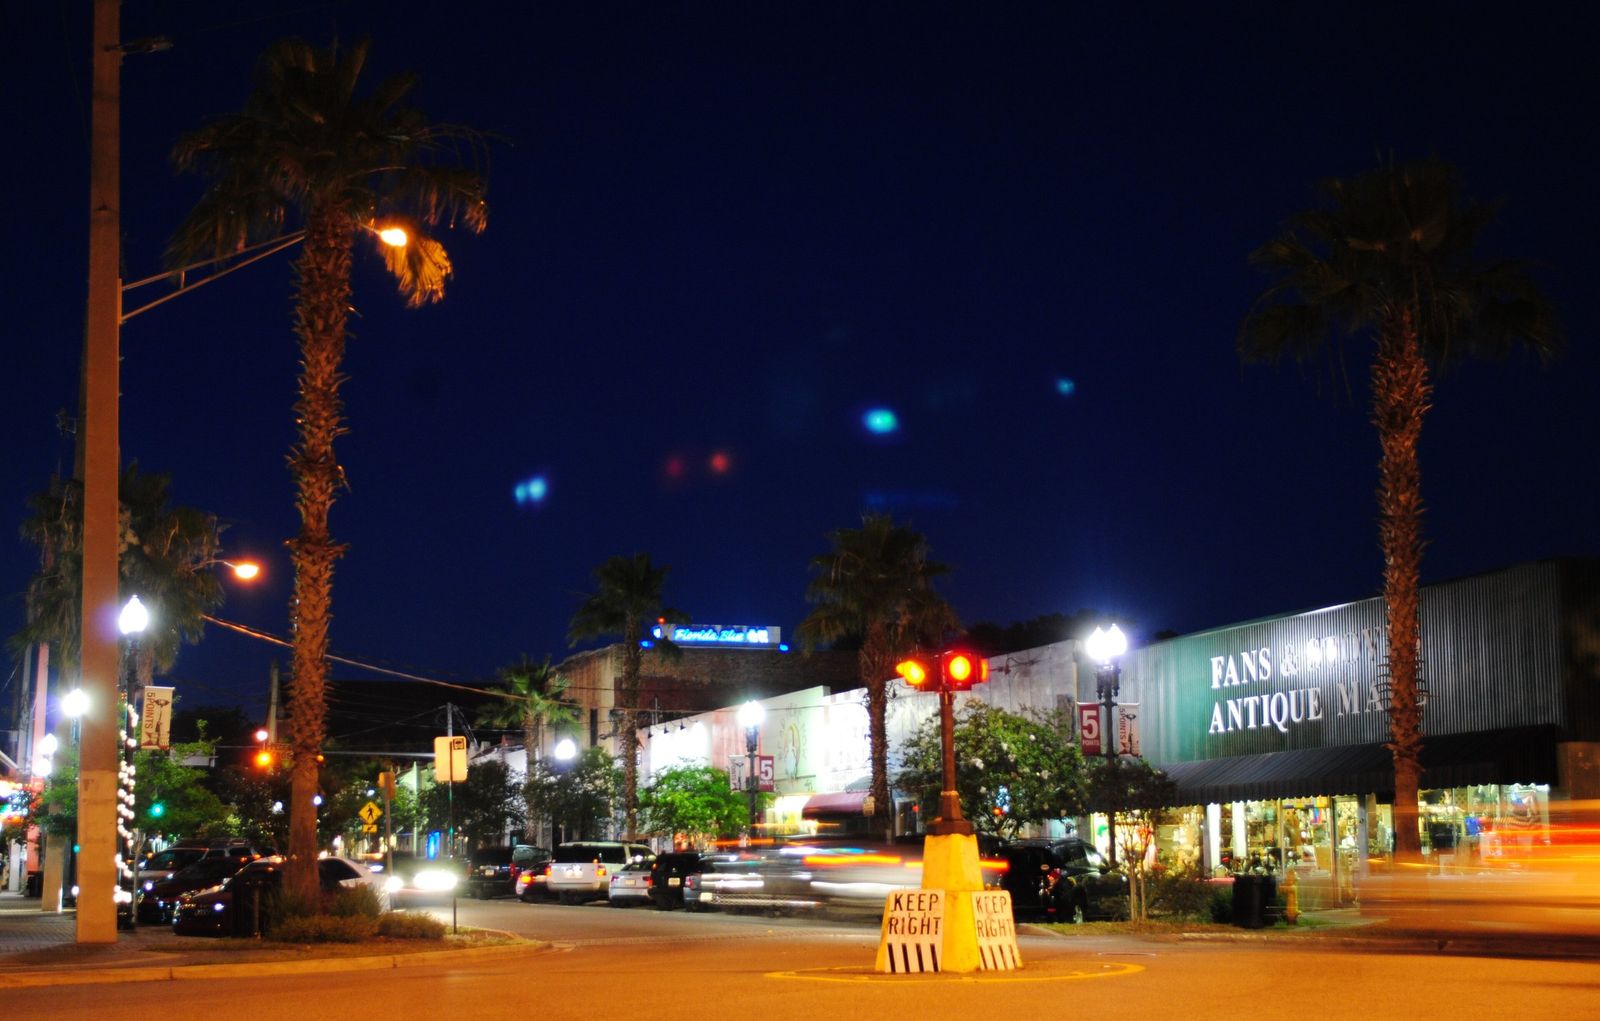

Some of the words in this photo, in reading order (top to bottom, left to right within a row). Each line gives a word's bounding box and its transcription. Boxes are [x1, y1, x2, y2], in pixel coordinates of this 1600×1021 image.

[674, 629, 717, 641] Florida
[719, 630, 744, 642] Blue
[1210, 647, 1271, 689] FANS
[1280, 643, 1298, 676] &
[1209, 687, 1323, 734] ANTIQUE
[1337, 679, 1428, 716] MA
[1082, 710, 1099, 739] 5
[760, 760, 773, 780] 5
[893, 893, 939, 911] KEEP
[975, 896, 1007, 913] KEEP
[888, 917, 942, 935] RIGHT
[977, 919, 1013, 937] RIGHT
